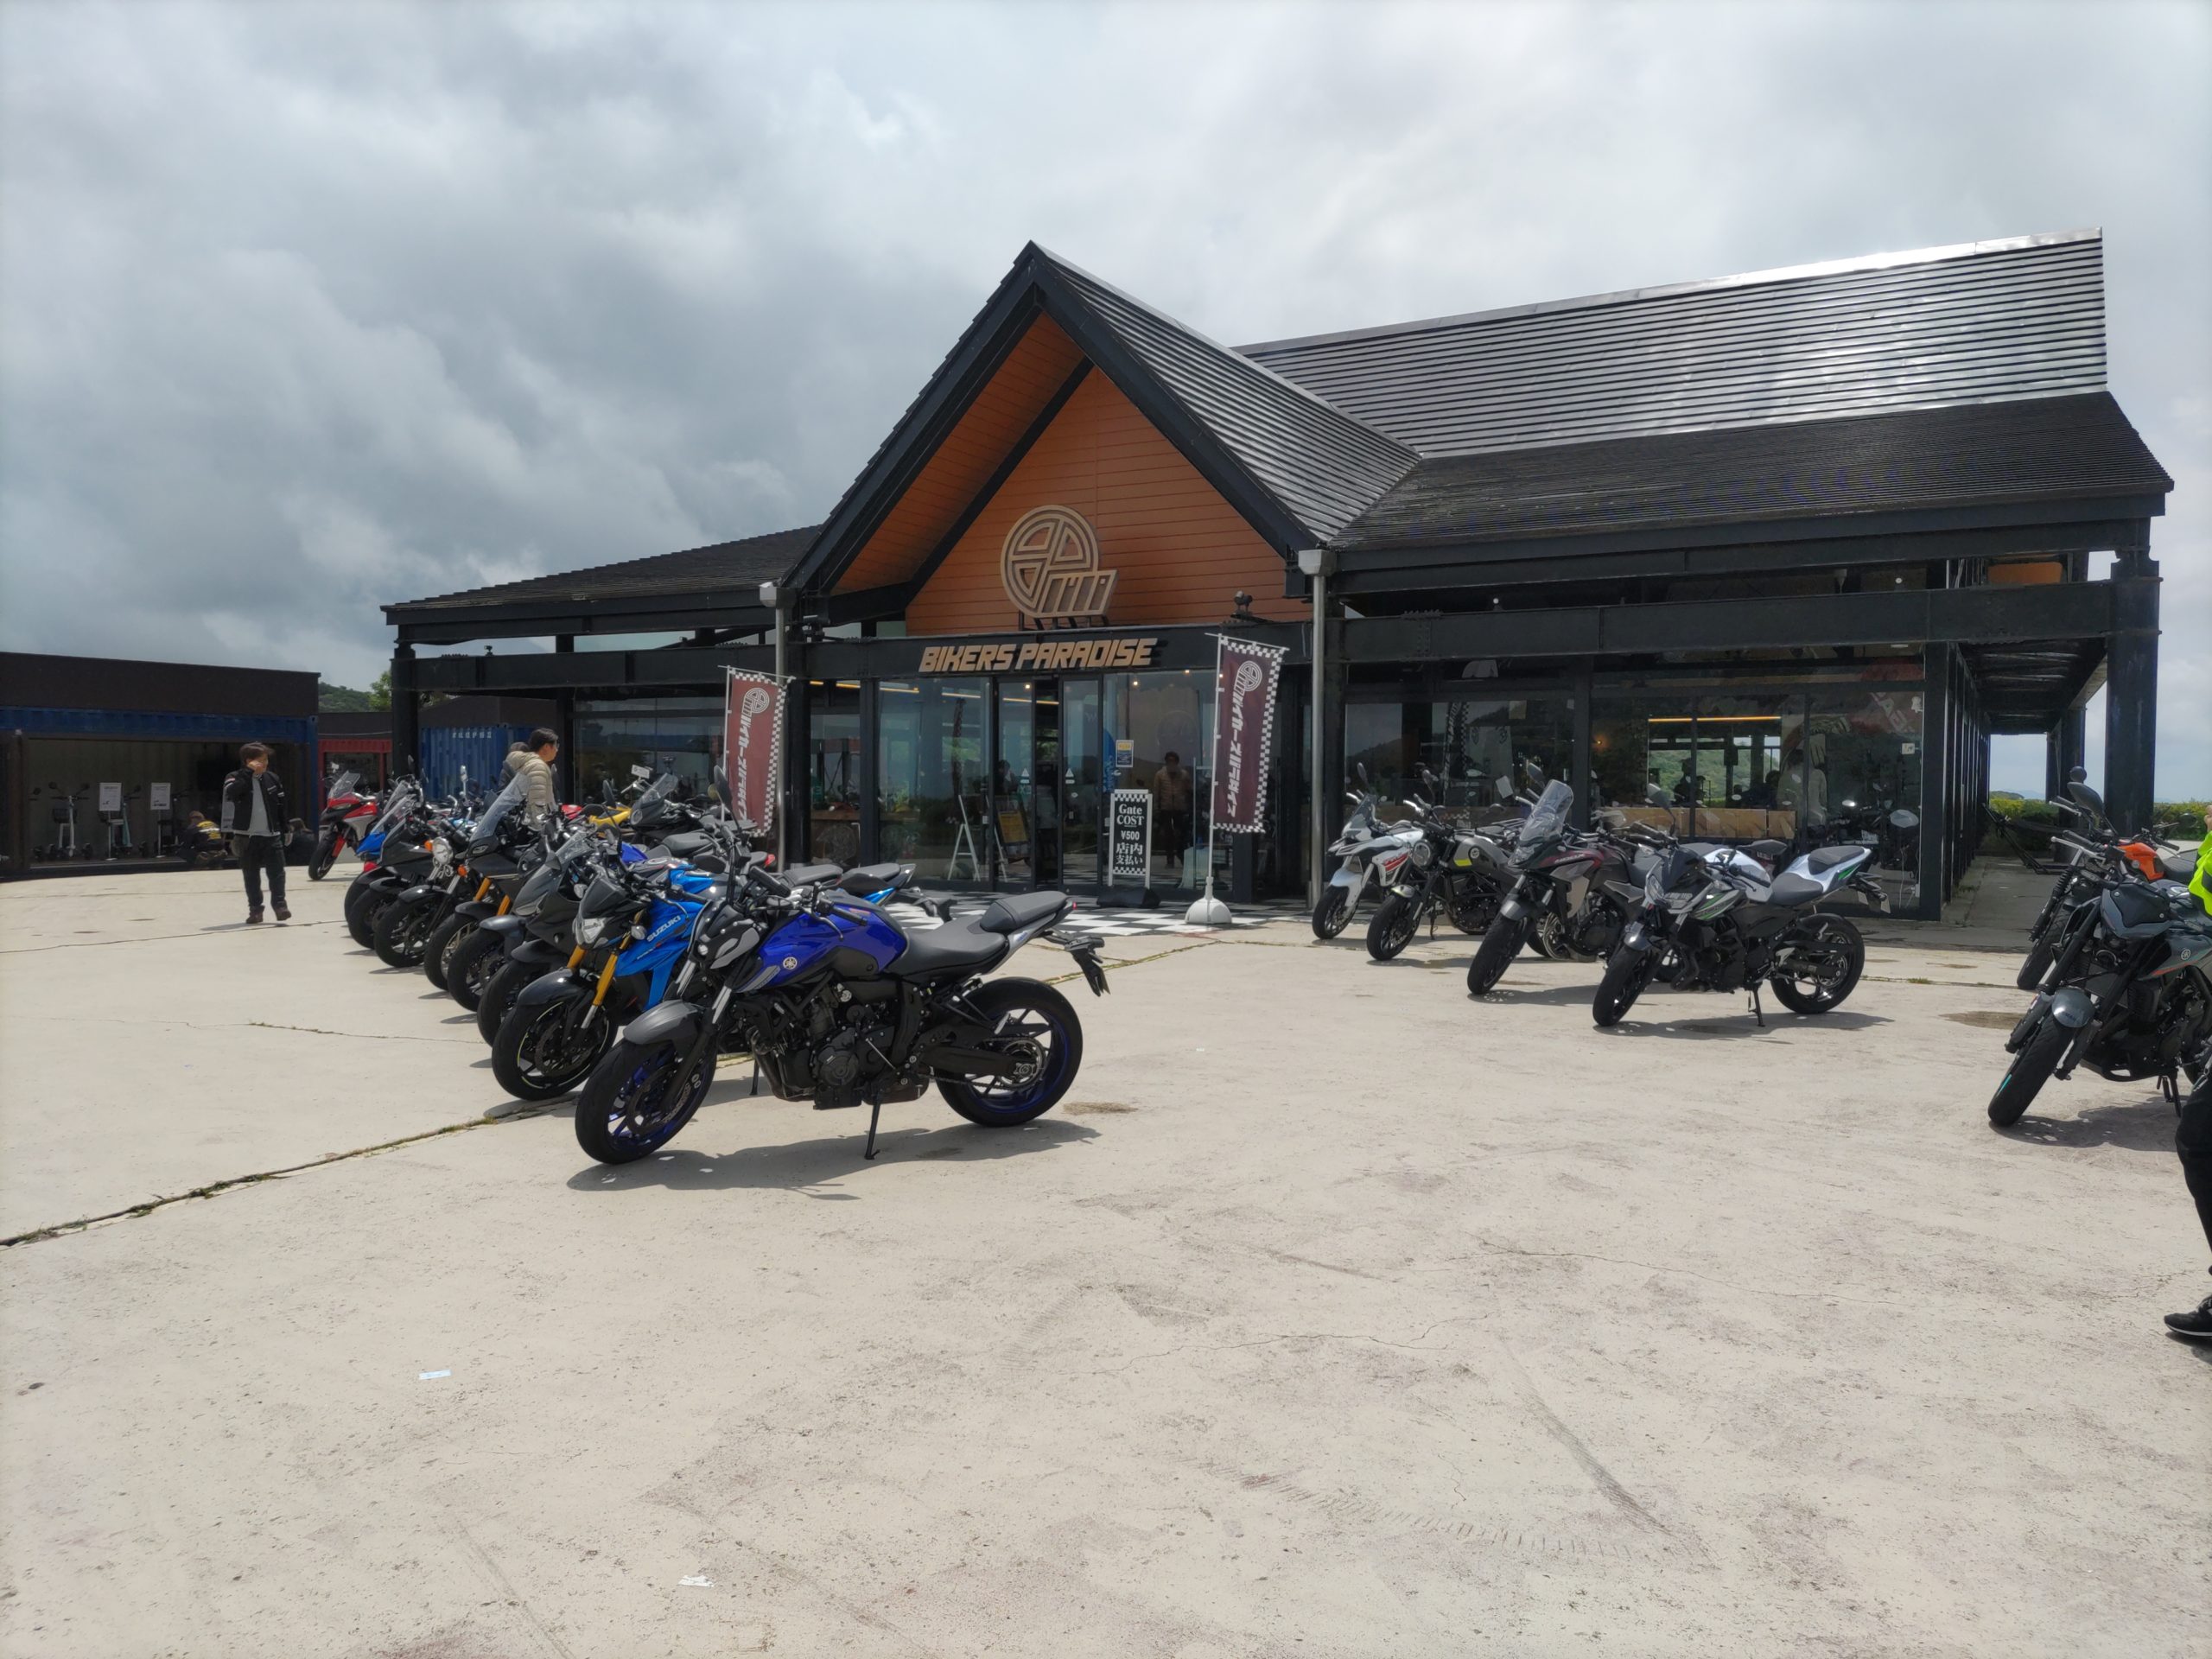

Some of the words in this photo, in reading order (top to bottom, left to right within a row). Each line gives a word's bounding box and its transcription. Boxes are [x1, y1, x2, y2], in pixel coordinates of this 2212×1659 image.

[918, 644, 1017, 672] BIKERS
[1014, 638, 1159, 671] PARADISE
[1119, 804, 1142, 815] Gate
[1116, 815, 1145, 825] COST
[1121, 830, 1140, 840] ¥500
[1116, 842, 1143, 855] 店内
[1116, 855, 1143, 865] 支払い
[646, 915, 681, 942] SUZUKI
